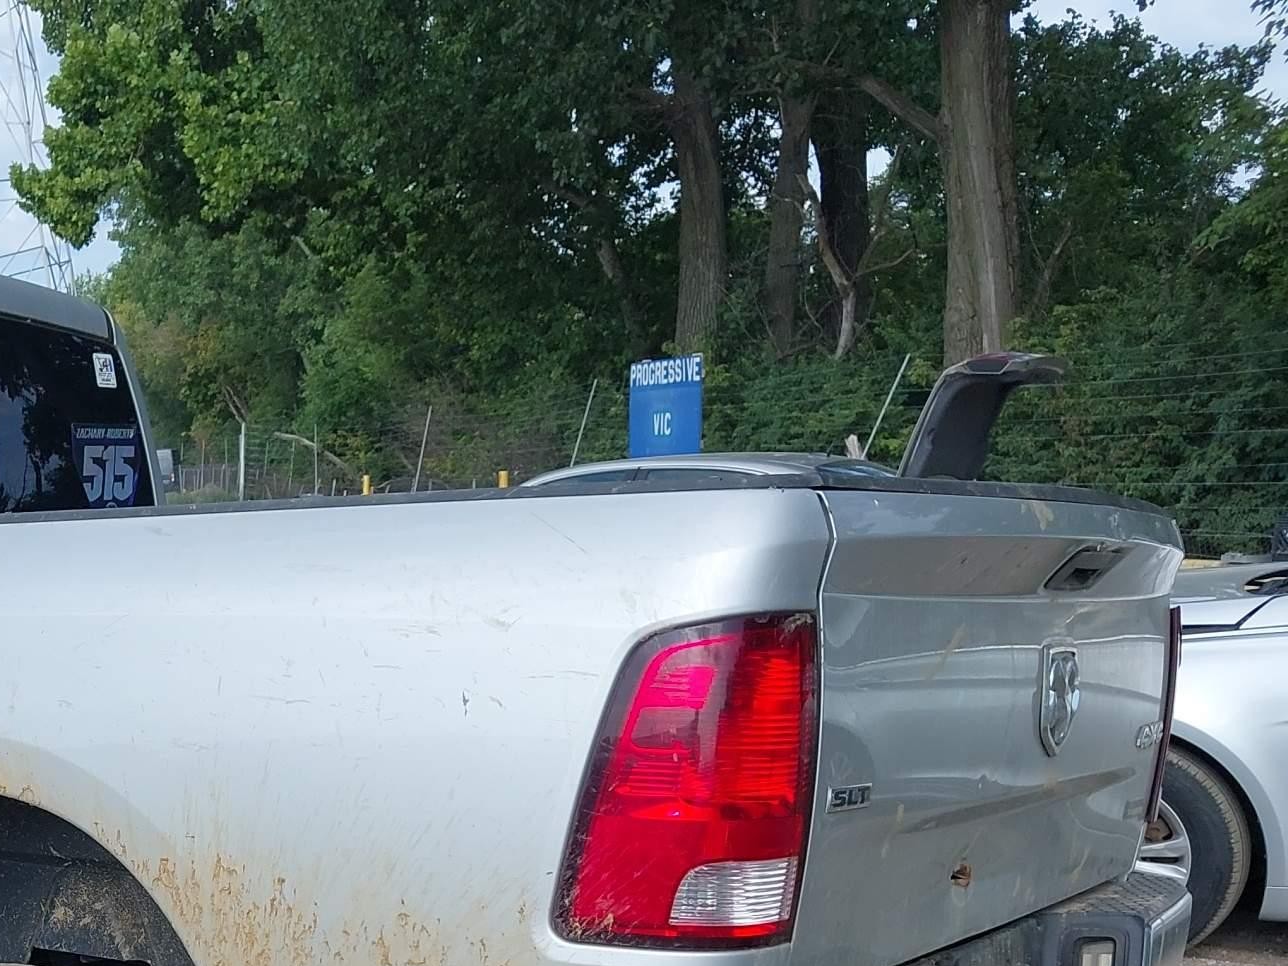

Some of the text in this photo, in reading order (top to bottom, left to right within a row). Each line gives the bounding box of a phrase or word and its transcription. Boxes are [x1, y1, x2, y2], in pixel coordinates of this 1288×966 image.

[630, 356, 701, 388] PROGRESSIVE
[653, 411, 672, 436] VIC
[83, 445, 135, 502] 515
[831, 785, 872, 810] SLT
